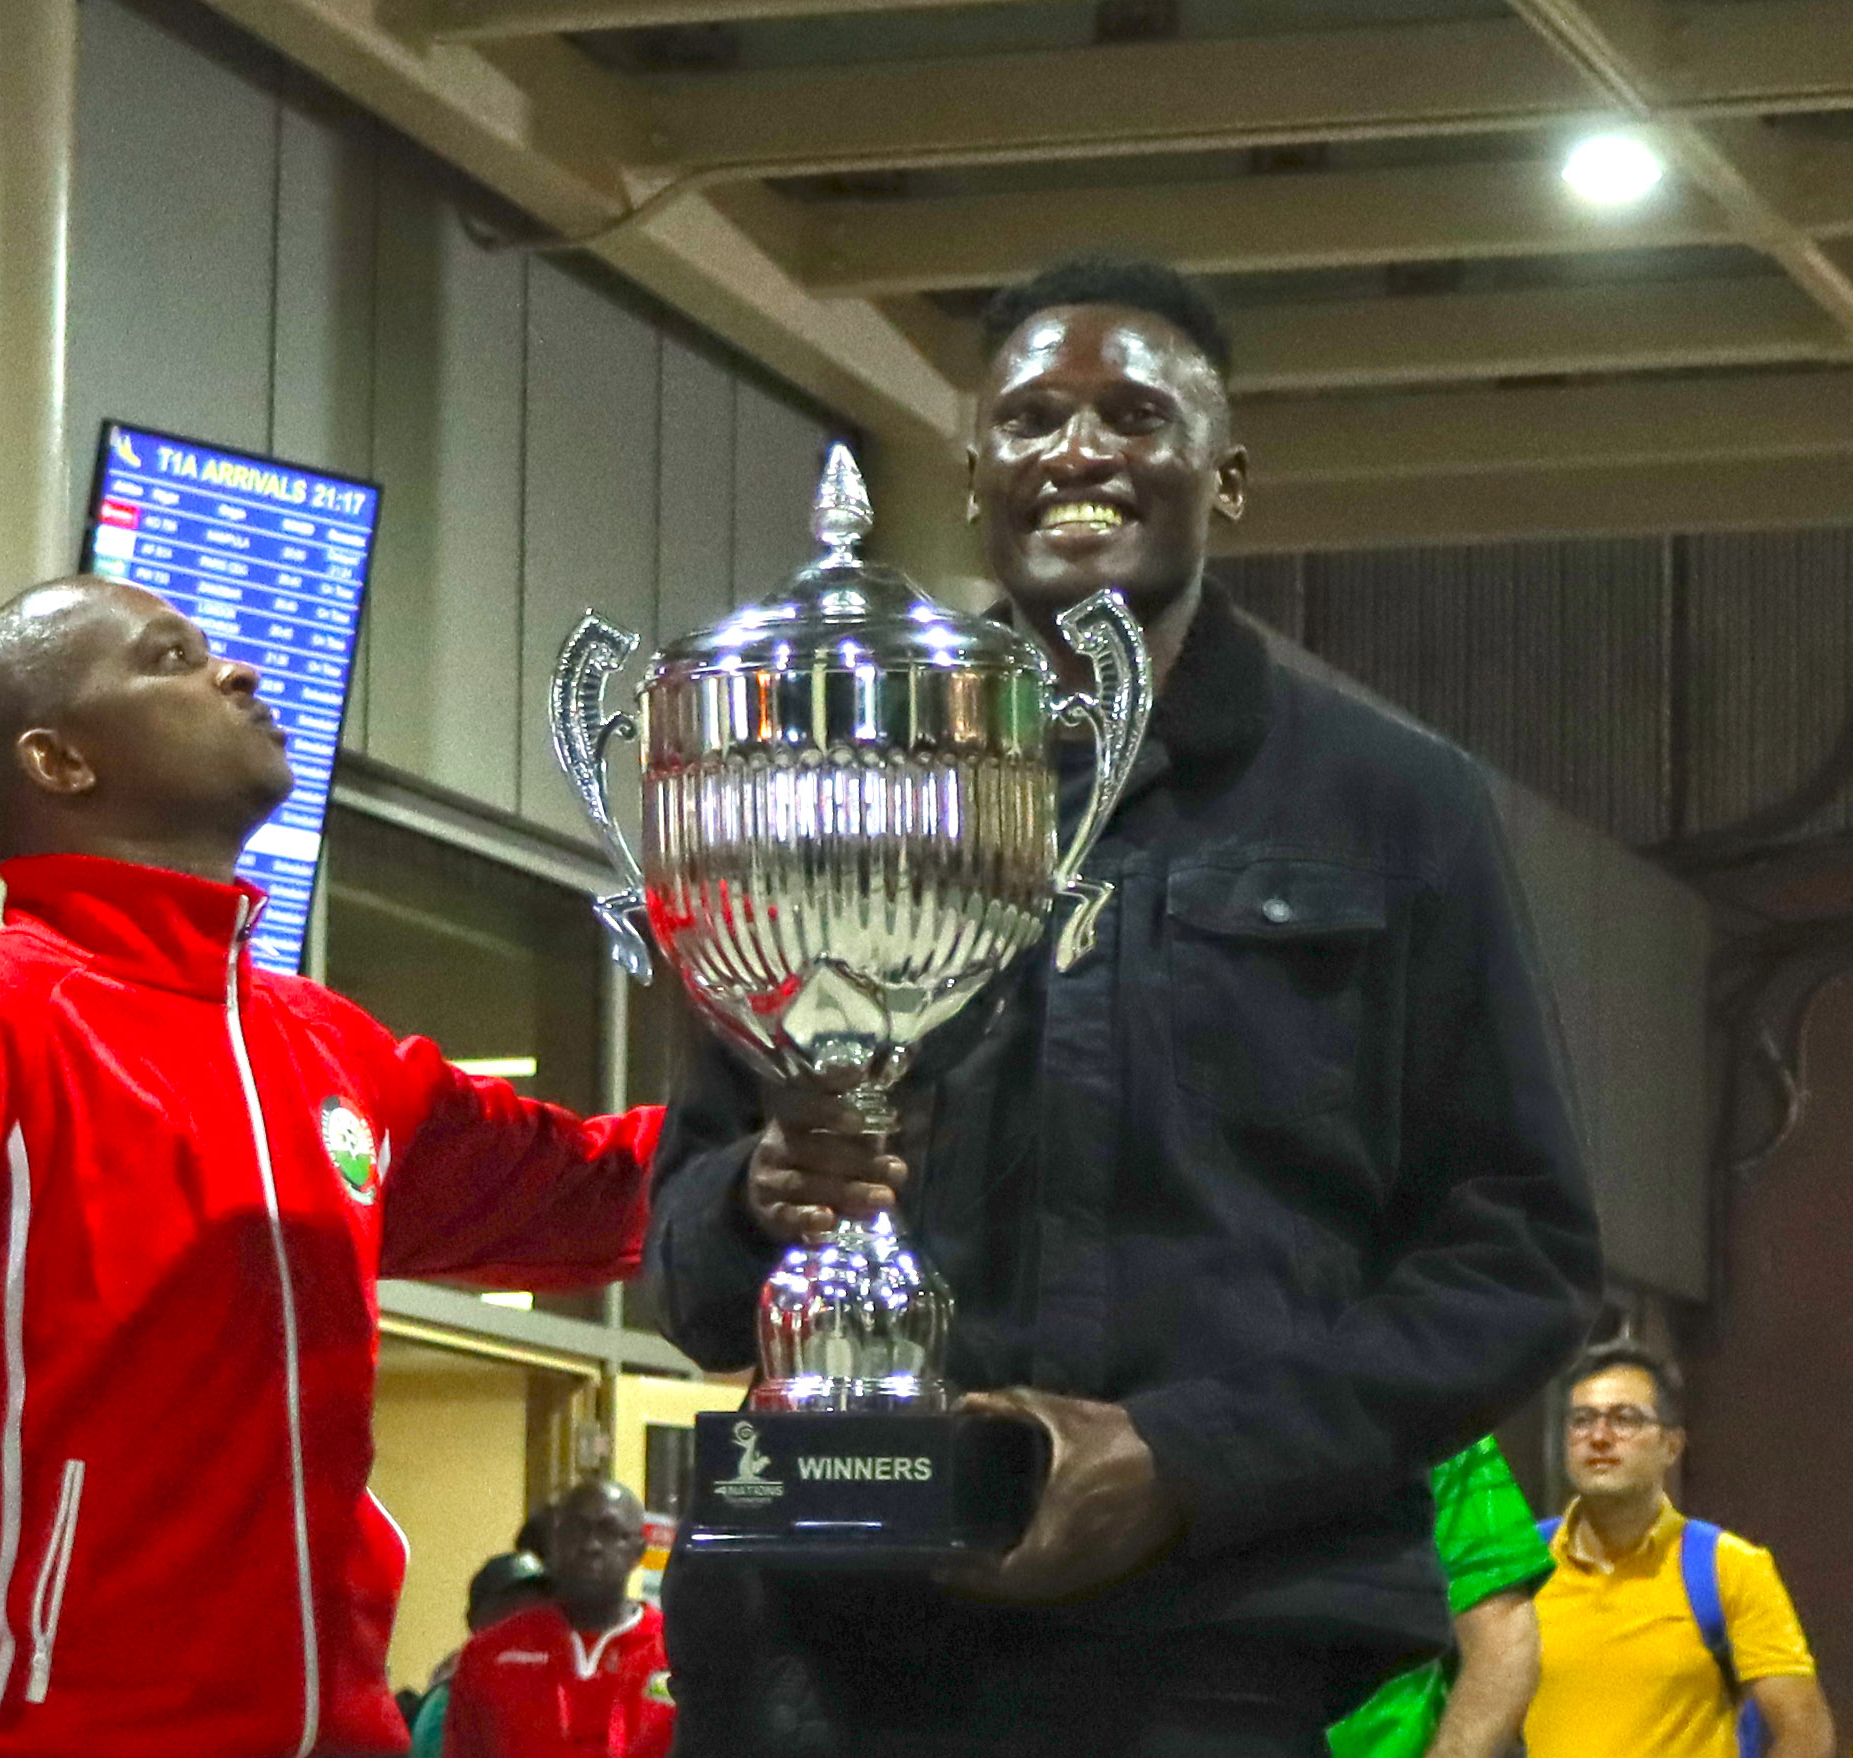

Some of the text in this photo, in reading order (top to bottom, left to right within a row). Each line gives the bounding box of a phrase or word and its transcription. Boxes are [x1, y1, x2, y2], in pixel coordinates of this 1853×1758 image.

[156, 446, 367, 516] T1A ARRIVALS 21:17
[797, 1456, 934, 1481] WINNERS
